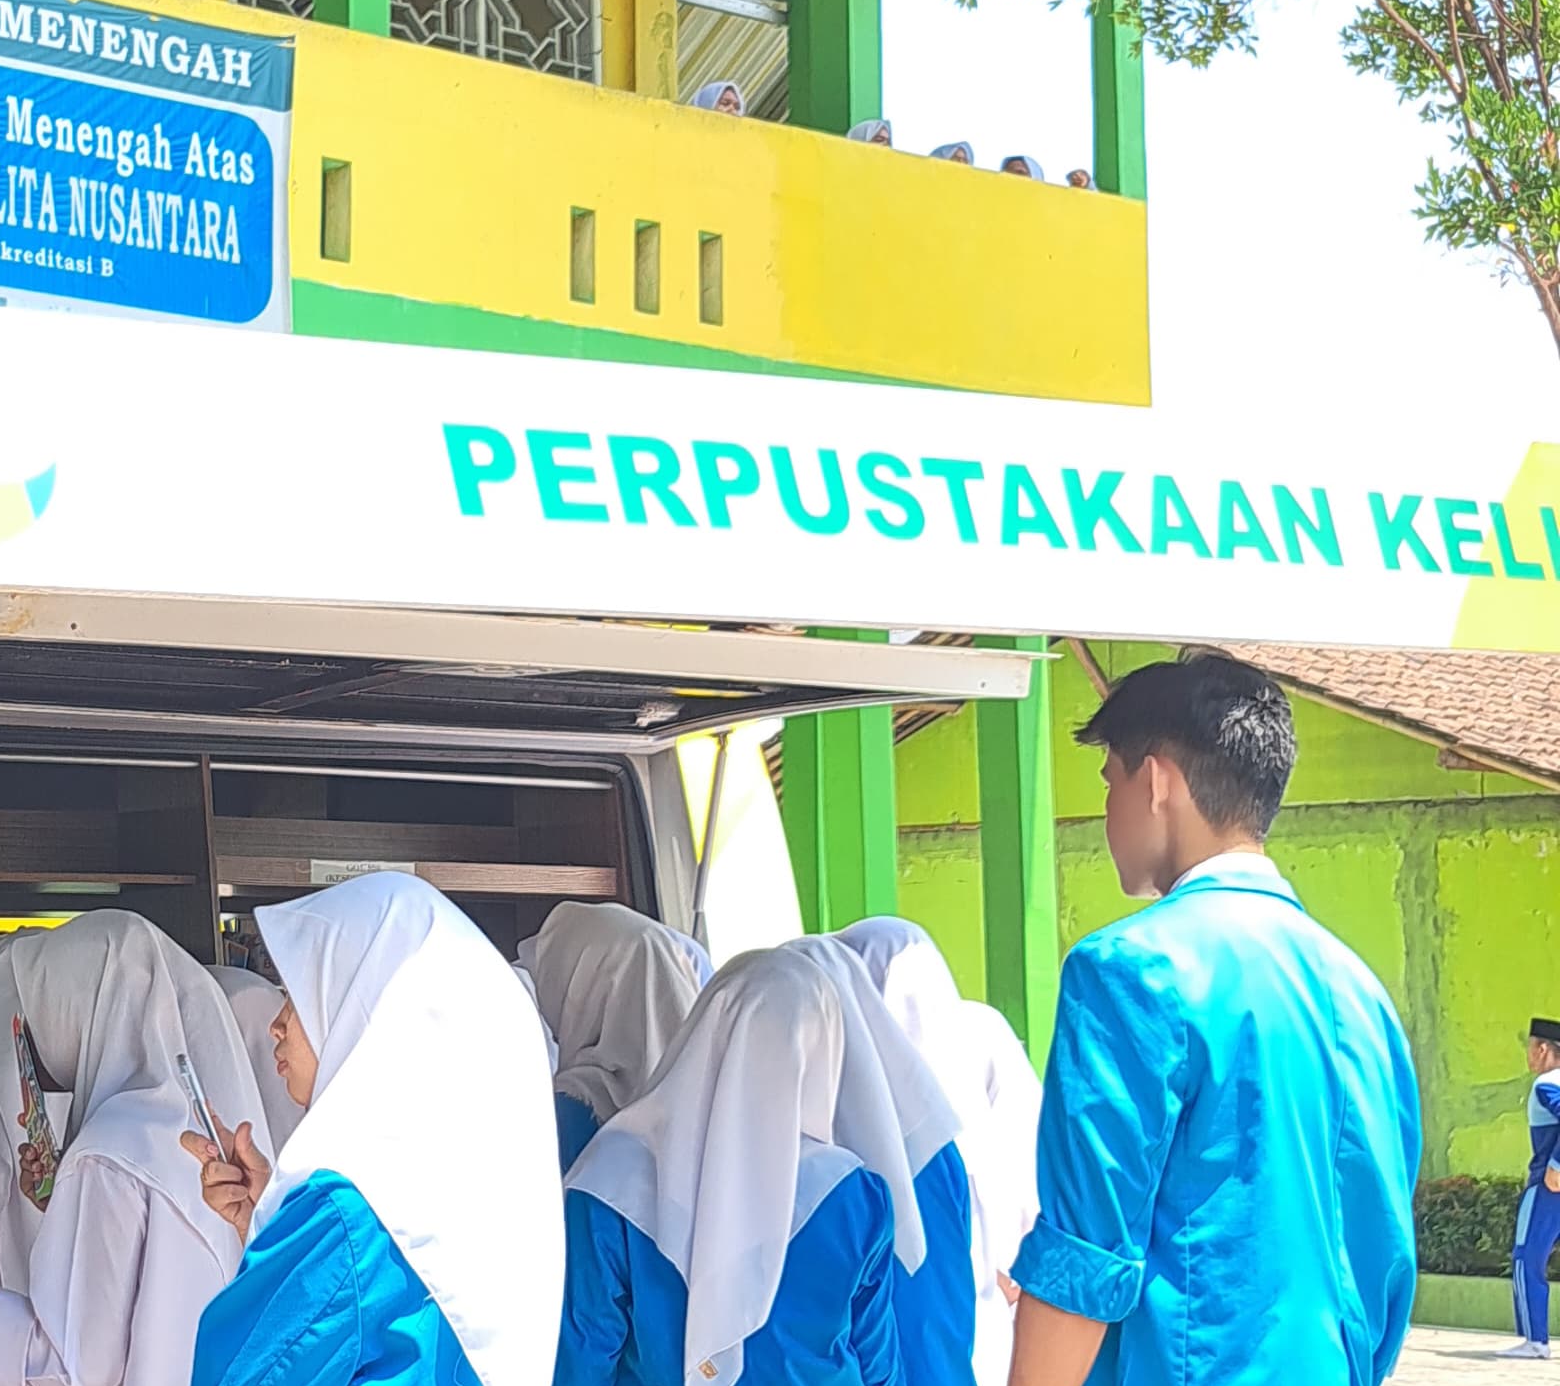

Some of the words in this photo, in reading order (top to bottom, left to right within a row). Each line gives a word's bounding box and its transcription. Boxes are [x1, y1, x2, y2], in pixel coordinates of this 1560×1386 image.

[6, 94, 173, 178] Menengah
[184, 132, 255, 185] Atas
[68, 175, 241, 265] NUSANTARA
[101, 257, 114, 278] B
[442, 422, 1344, 568] PERPUSTAKAAN
